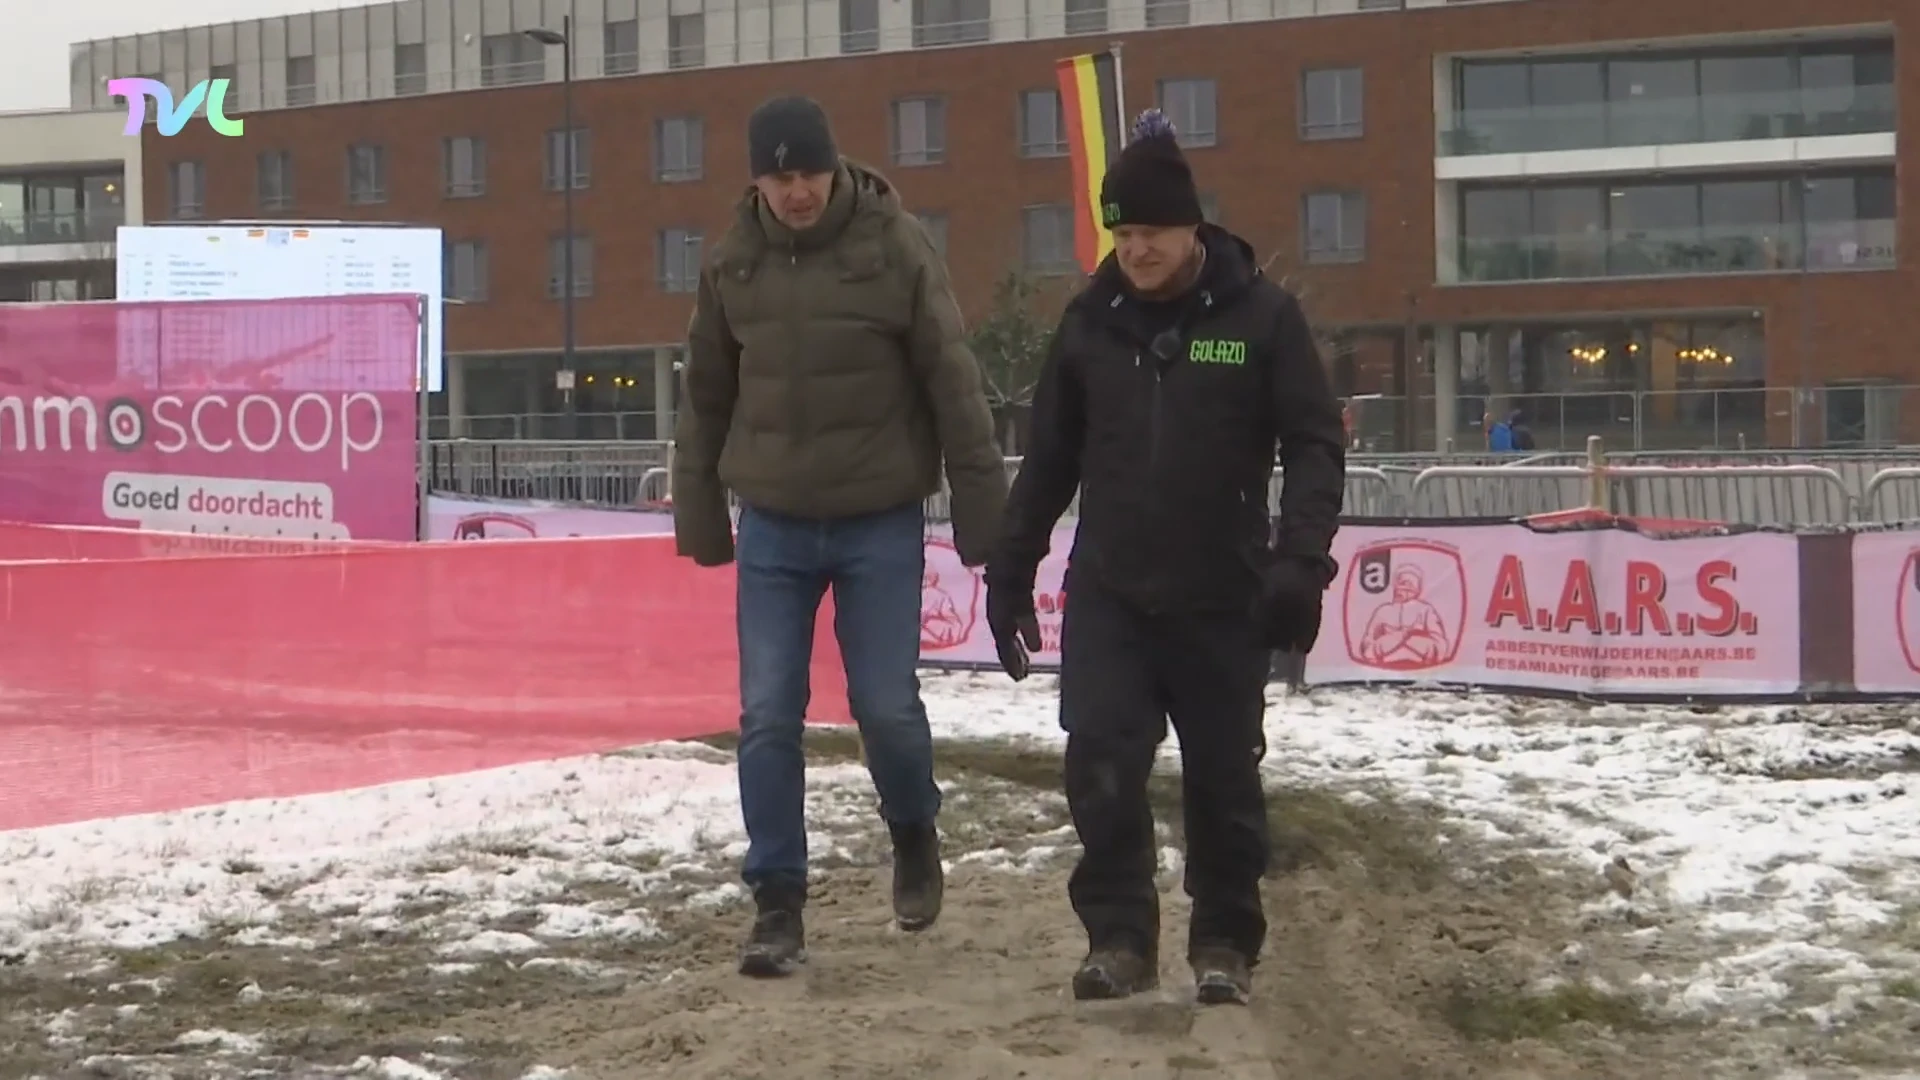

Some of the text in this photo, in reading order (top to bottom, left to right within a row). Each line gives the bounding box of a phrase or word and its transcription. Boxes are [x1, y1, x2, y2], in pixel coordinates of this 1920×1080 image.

[1189, 339, 1246, 365] GOLAZO
[112, 482, 324, 520] Goed doordacht
[1484, 554, 1758, 637] A.A.R.S.
